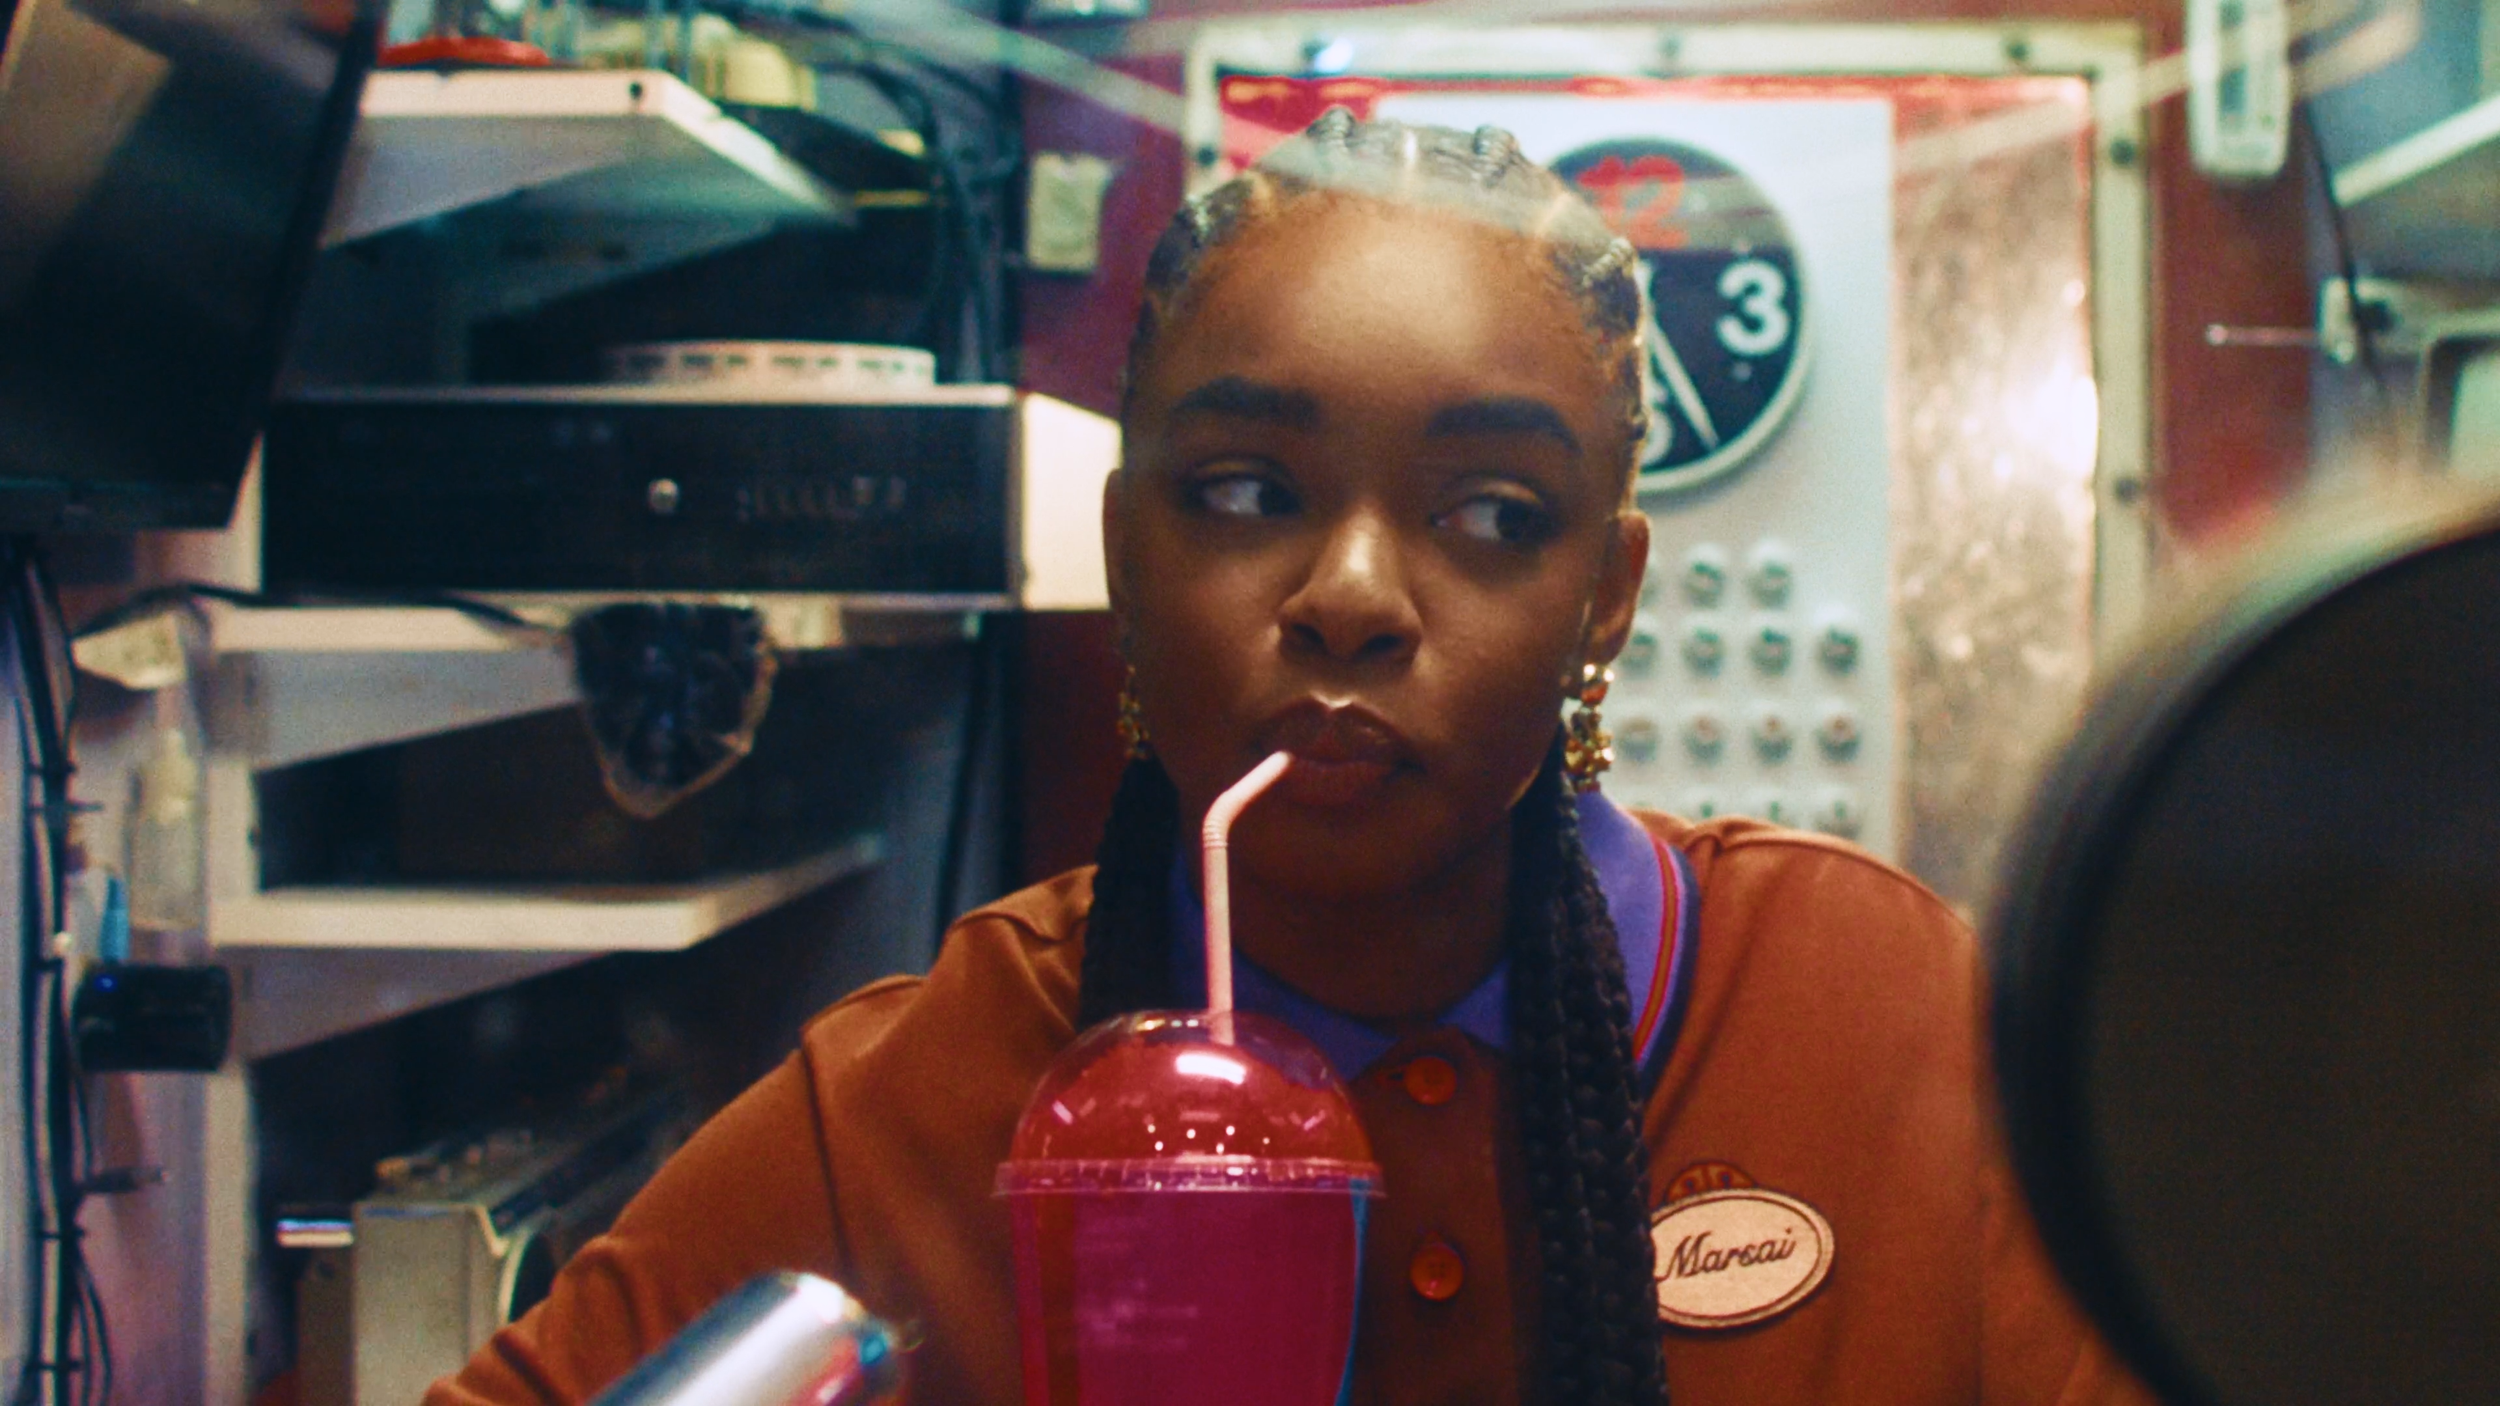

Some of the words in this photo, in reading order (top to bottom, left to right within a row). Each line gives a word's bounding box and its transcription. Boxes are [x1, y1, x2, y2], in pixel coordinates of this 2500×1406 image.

[1576, 154, 1689, 249] 12
[1716, 259, 1789, 354] 3
[1653, 1227, 1797, 1282] Marsai
